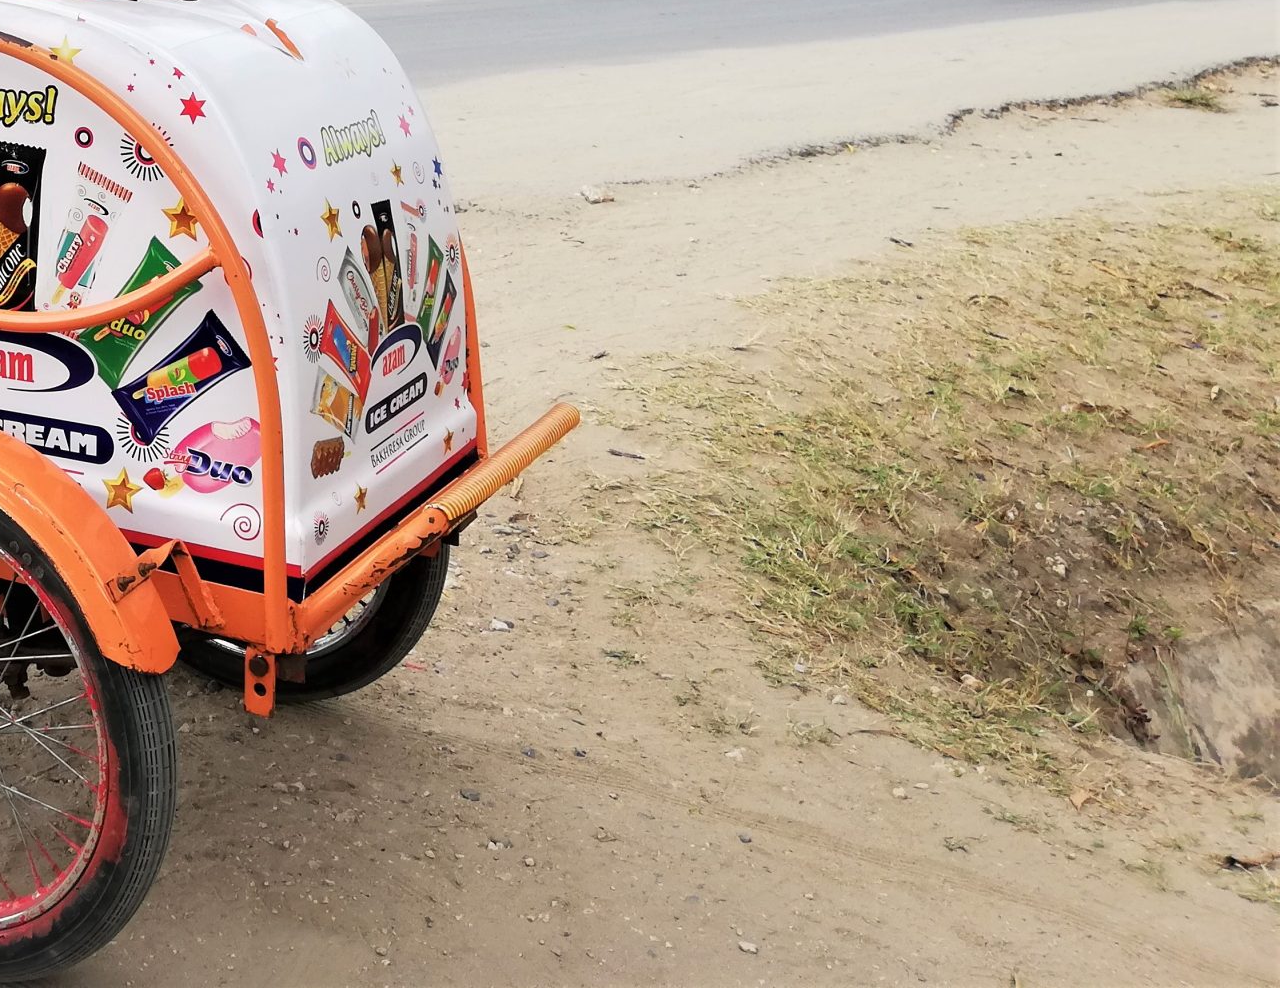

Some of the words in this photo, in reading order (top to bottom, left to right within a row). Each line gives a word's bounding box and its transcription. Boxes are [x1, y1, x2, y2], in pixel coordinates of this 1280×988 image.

[321, 109, 386, 167] Always!
[56, 233, 84, 274] Cherry
[110, 317, 146, 341] duo
[382, 343, 406, 377] azam
[145, 382, 197, 402] Splash
[370, 403, 388, 428] ICE
[390, 379, 424, 417] CREAM
[186, 446, 253, 486] Duo
[370, 436, 404, 468] BAKHRESA
